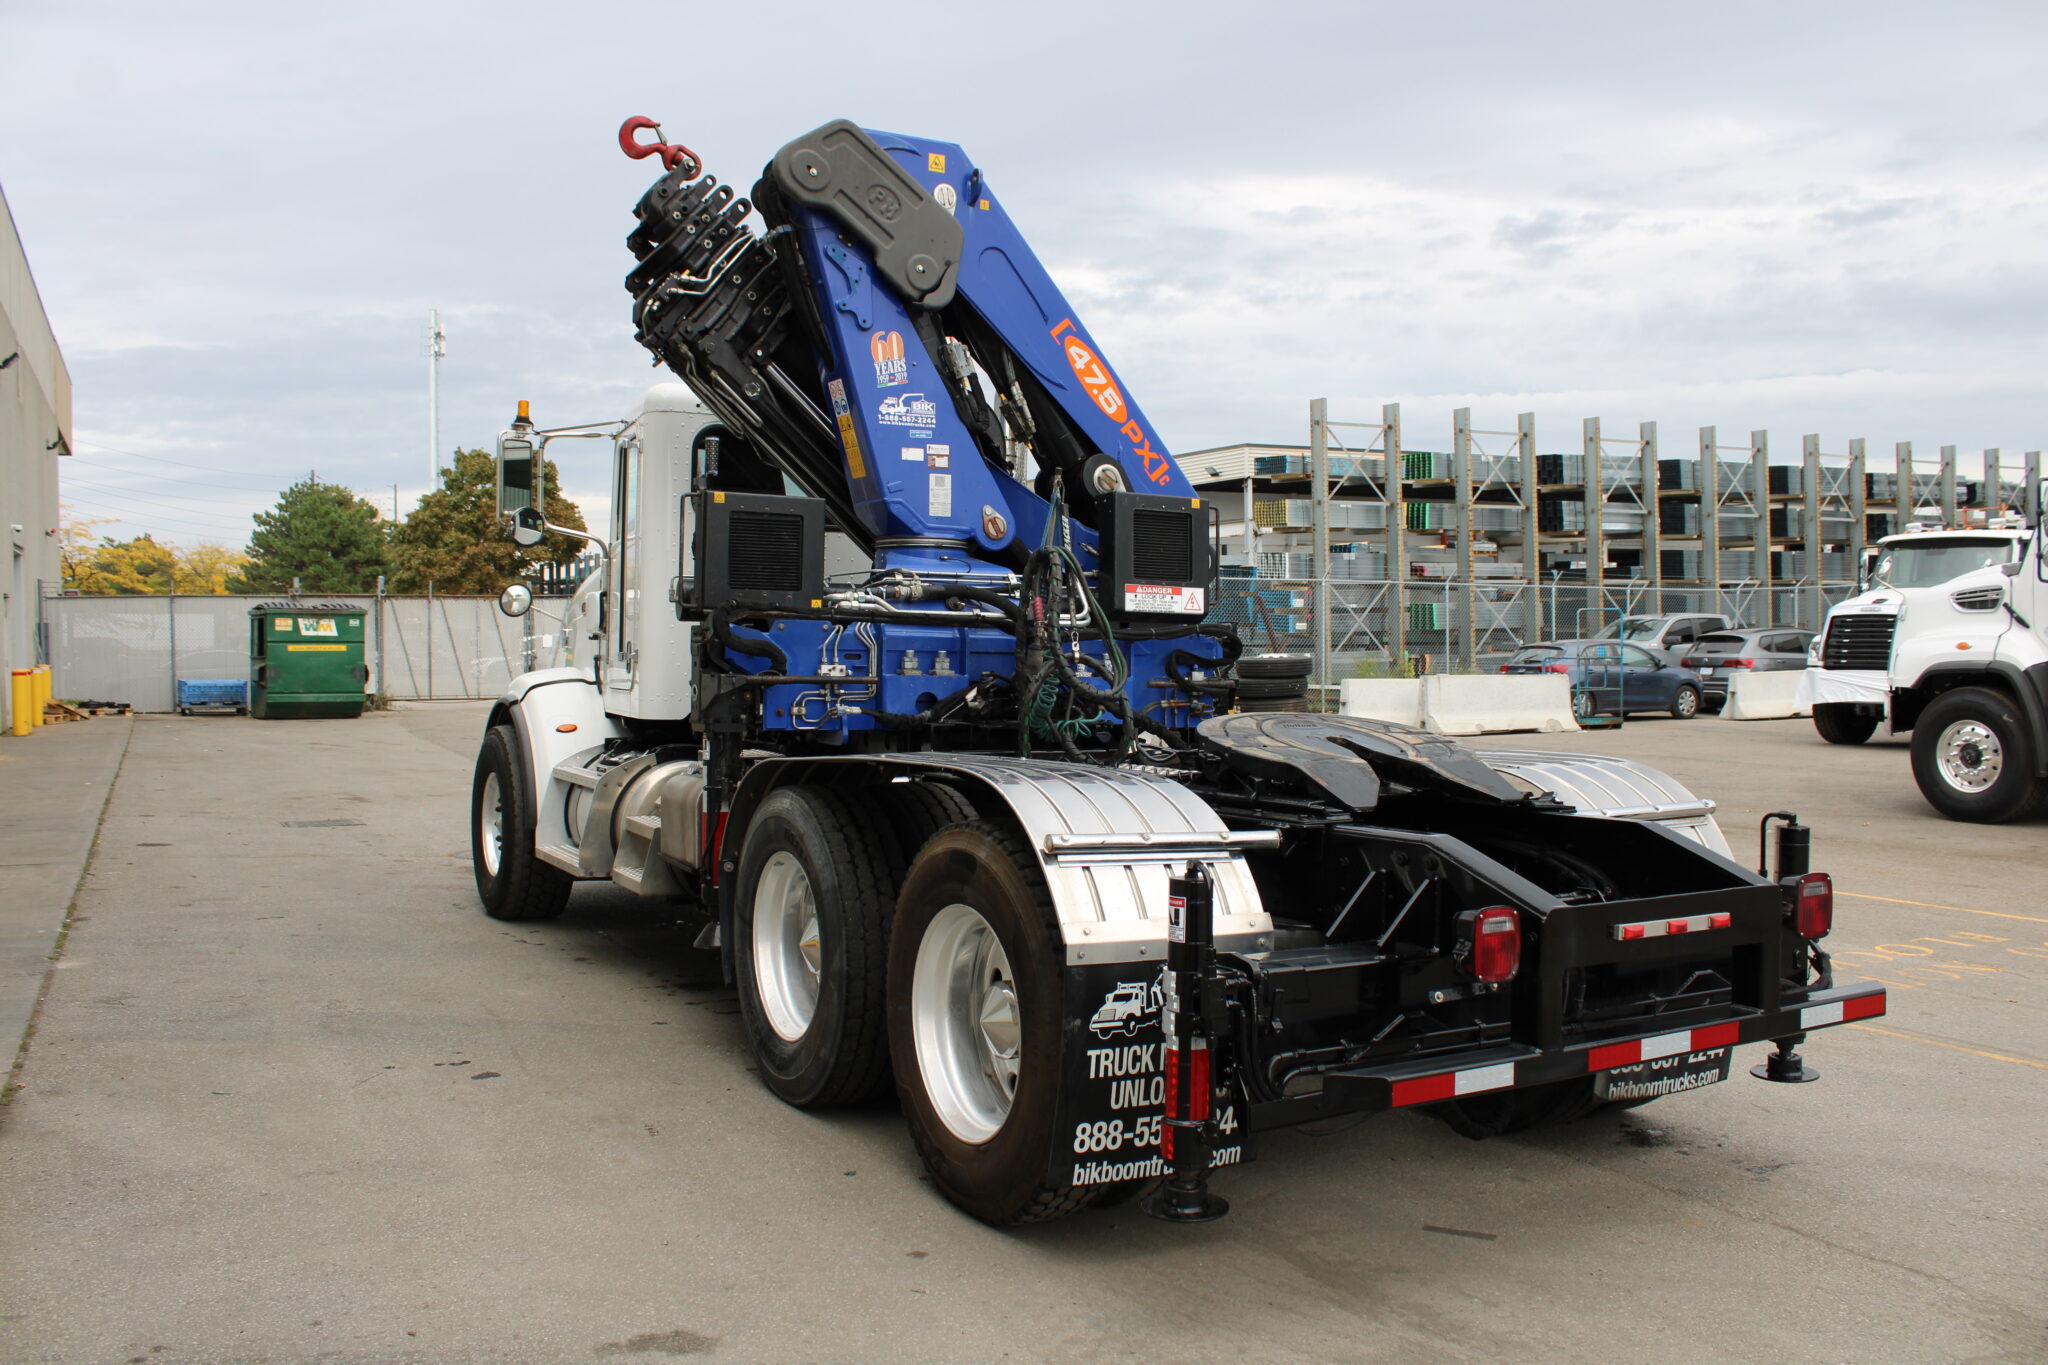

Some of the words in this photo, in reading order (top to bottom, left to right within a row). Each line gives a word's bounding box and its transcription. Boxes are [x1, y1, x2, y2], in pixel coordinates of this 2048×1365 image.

[871, 331, 904, 362] 60
[874, 357, 907, 376] YEARS
[912, 402, 934, 412] BIK
[304, 623, 334, 633] WM
[1087, 1043, 1156, 1079] TRUCK
[1110, 1076, 1166, 1110] UNLO
[1608, 1068, 1720, 1101] bikboomtrucks.com
